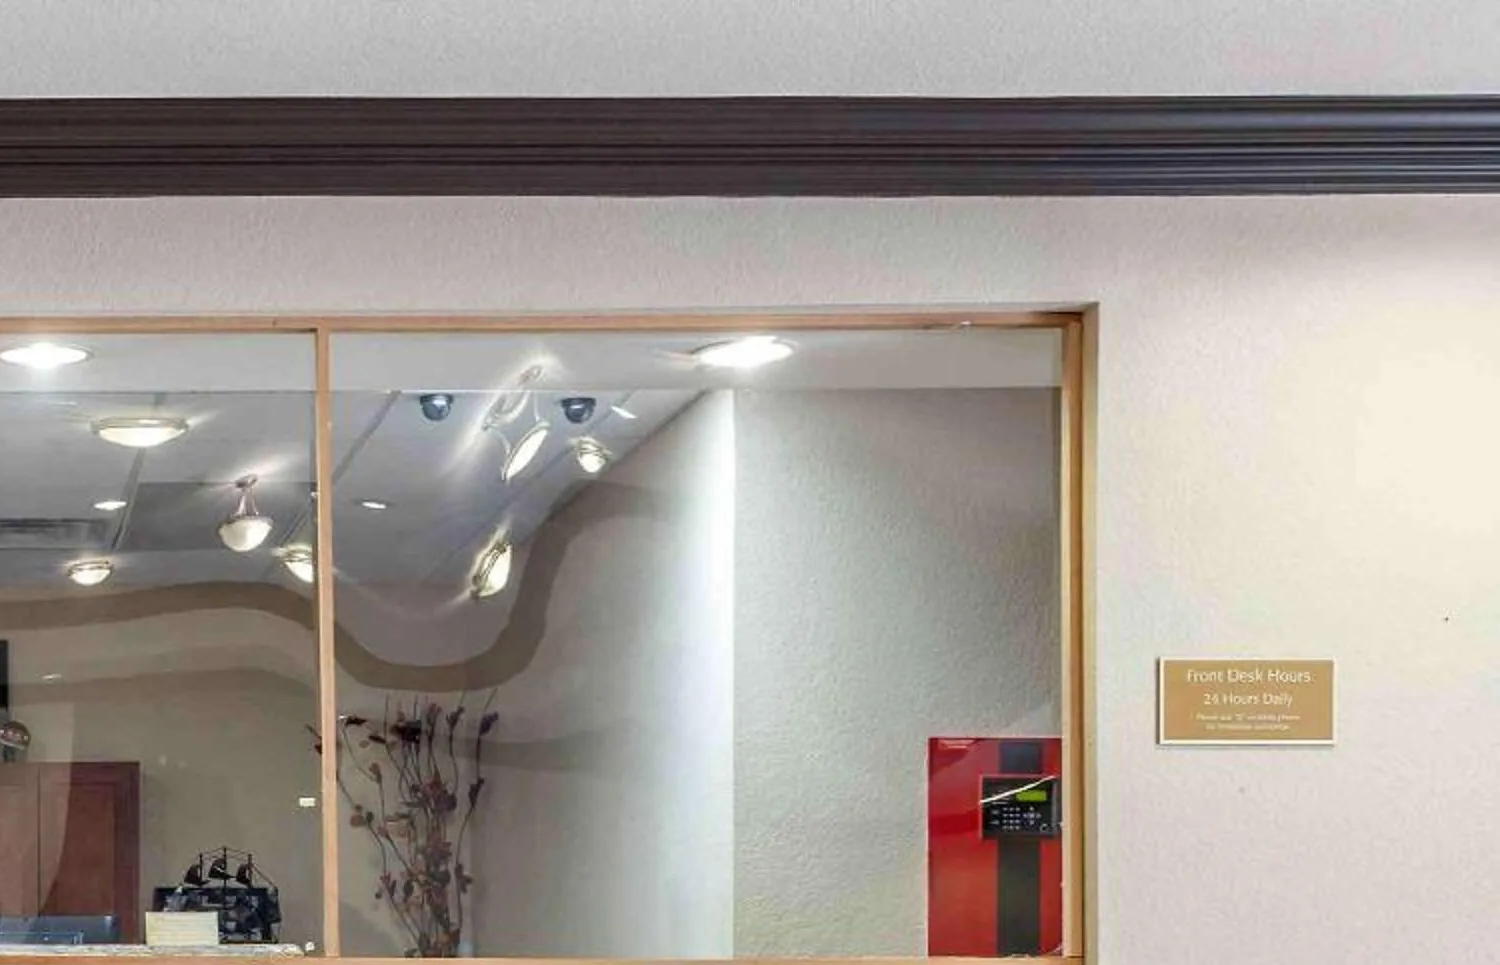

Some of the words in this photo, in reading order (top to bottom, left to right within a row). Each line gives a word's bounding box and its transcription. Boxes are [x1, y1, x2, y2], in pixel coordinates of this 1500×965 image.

[1187, 669, 1223, 682] Front
[1227, 668, 1263, 682] Desk
[1267, 669, 1311, 682] Hours
[1203, 693, 1219, 705] 24
[1223, 692, 1260, 705] Hours
[1262, 692, 1293, 707] Daily
